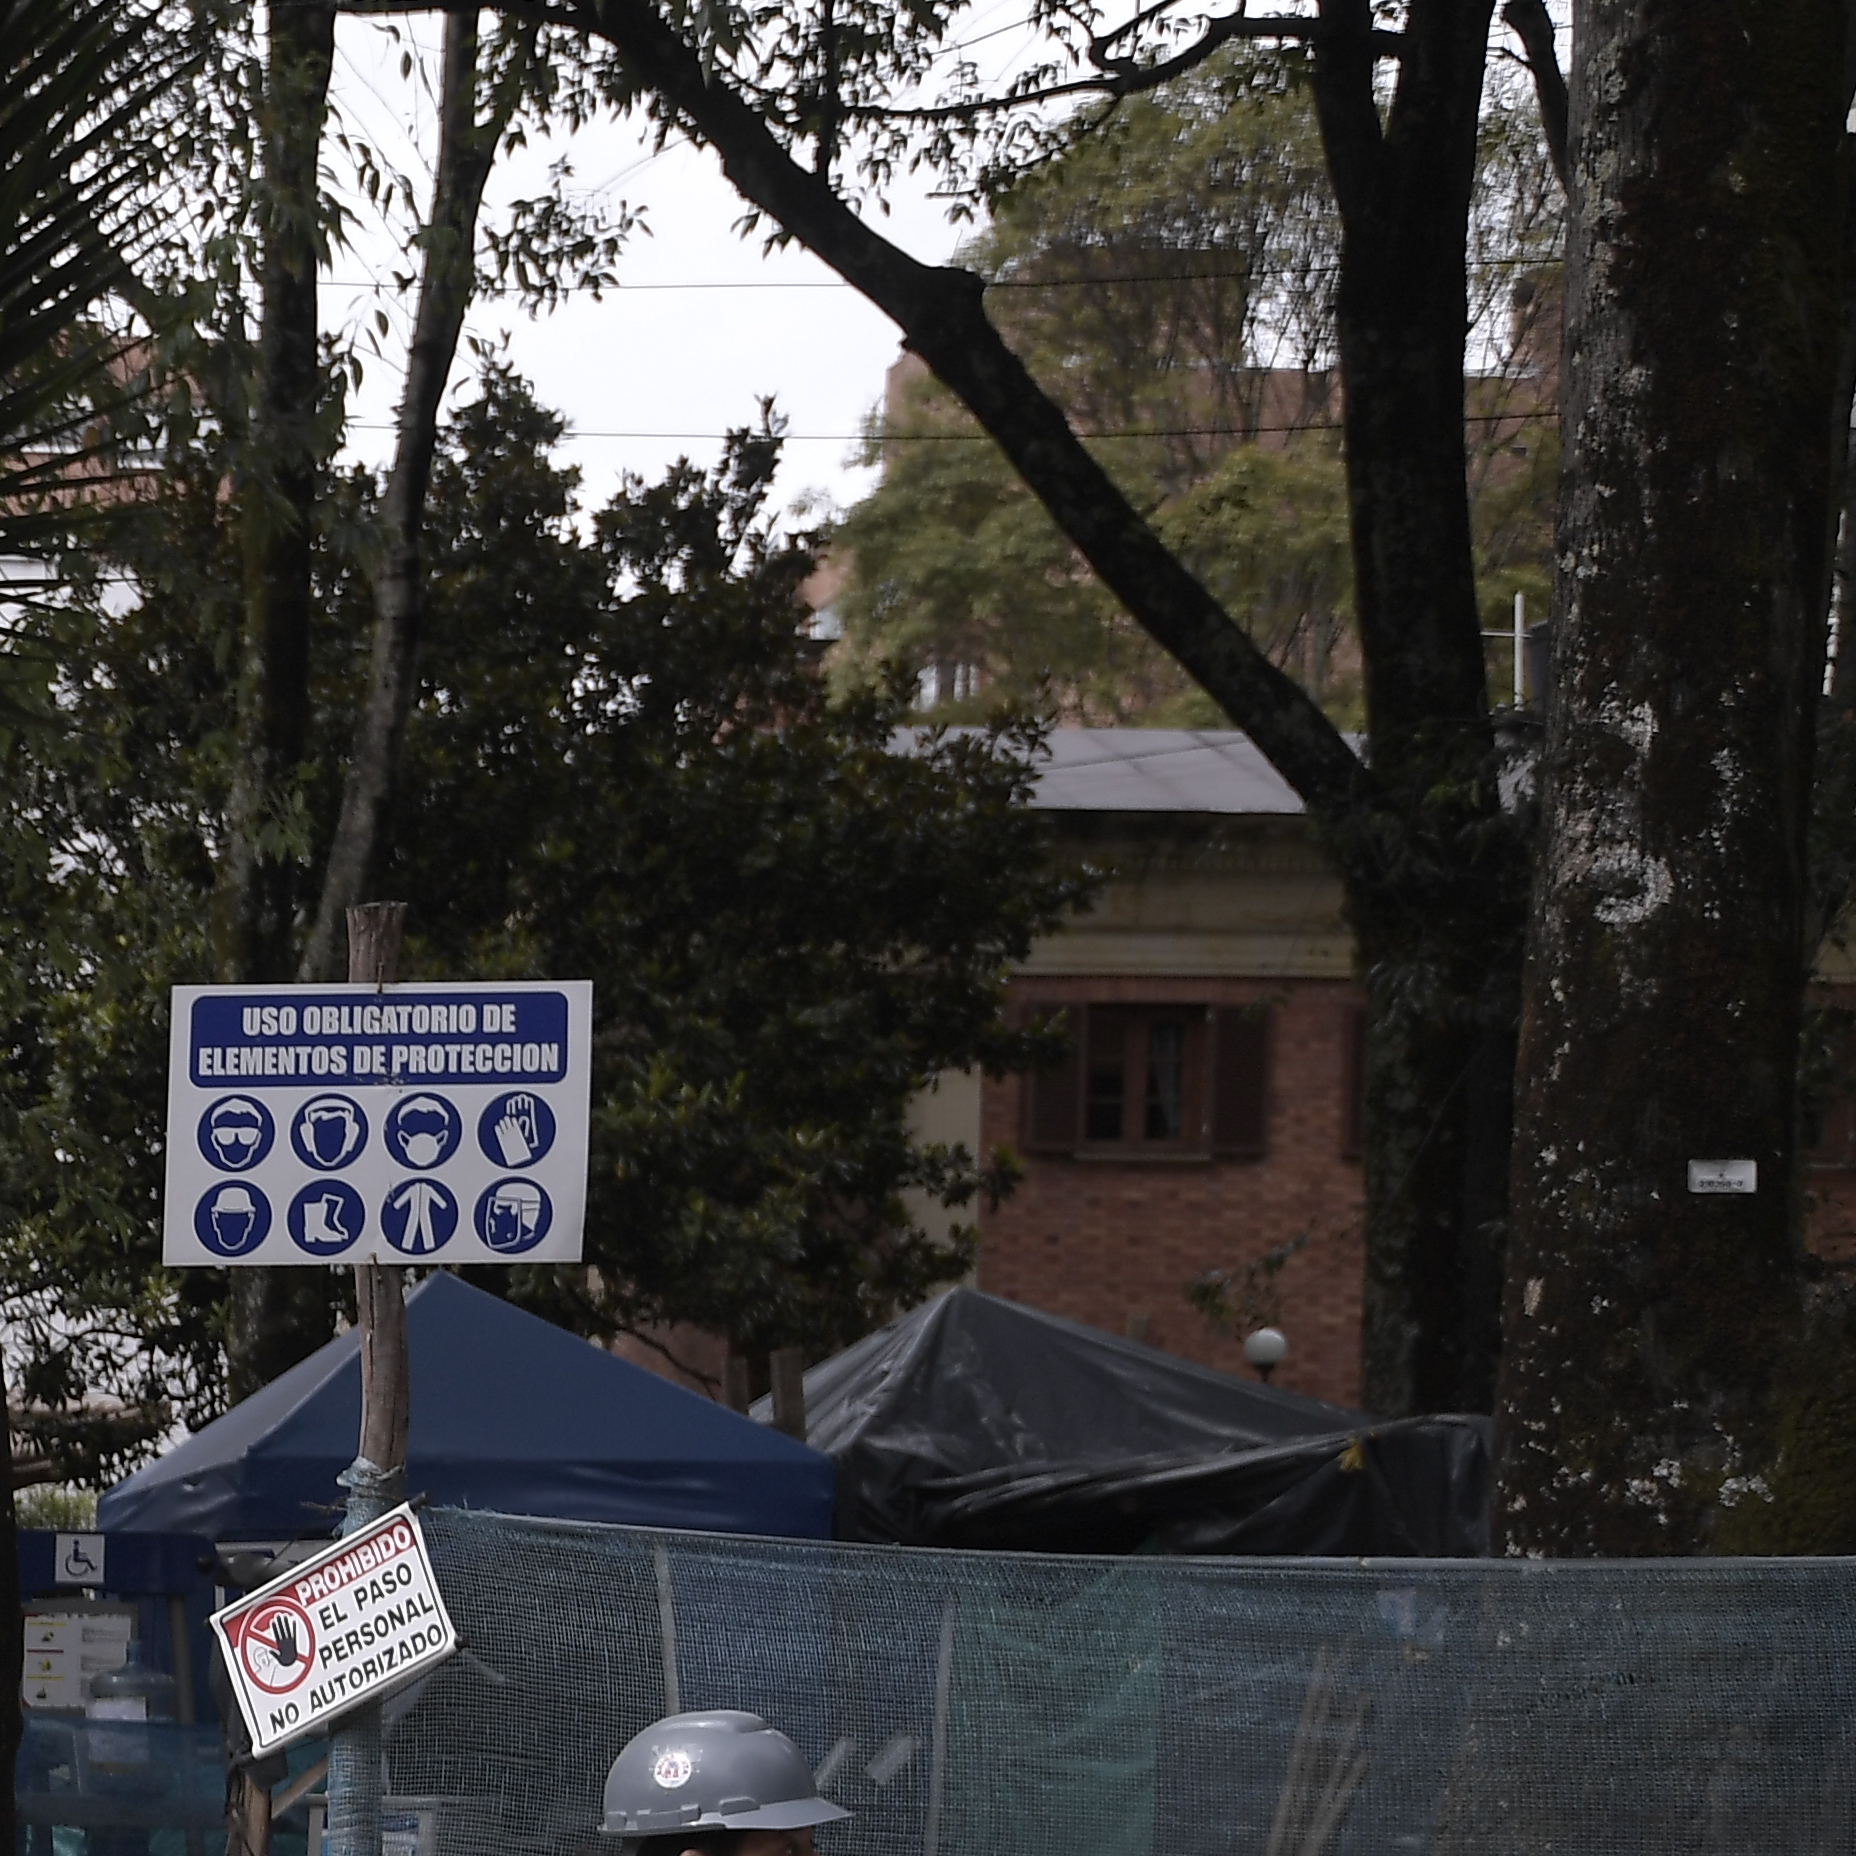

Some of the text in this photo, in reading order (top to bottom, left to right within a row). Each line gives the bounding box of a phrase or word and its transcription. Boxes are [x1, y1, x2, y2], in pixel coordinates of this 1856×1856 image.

[242, 1004, 516, 1036] USO OBLIGATORIO DE
[198, 1043, 559, 1076] ELEMENTOS DE PROTECCION
[294, 1524, 412, 1606] PROHIBIDO
[318, 1562, 412, 1631] EL PASO
[318, 1591, 434, 1670] PERSONAL
[268, 1623, 443, 1735] NO AUTORIZADO
